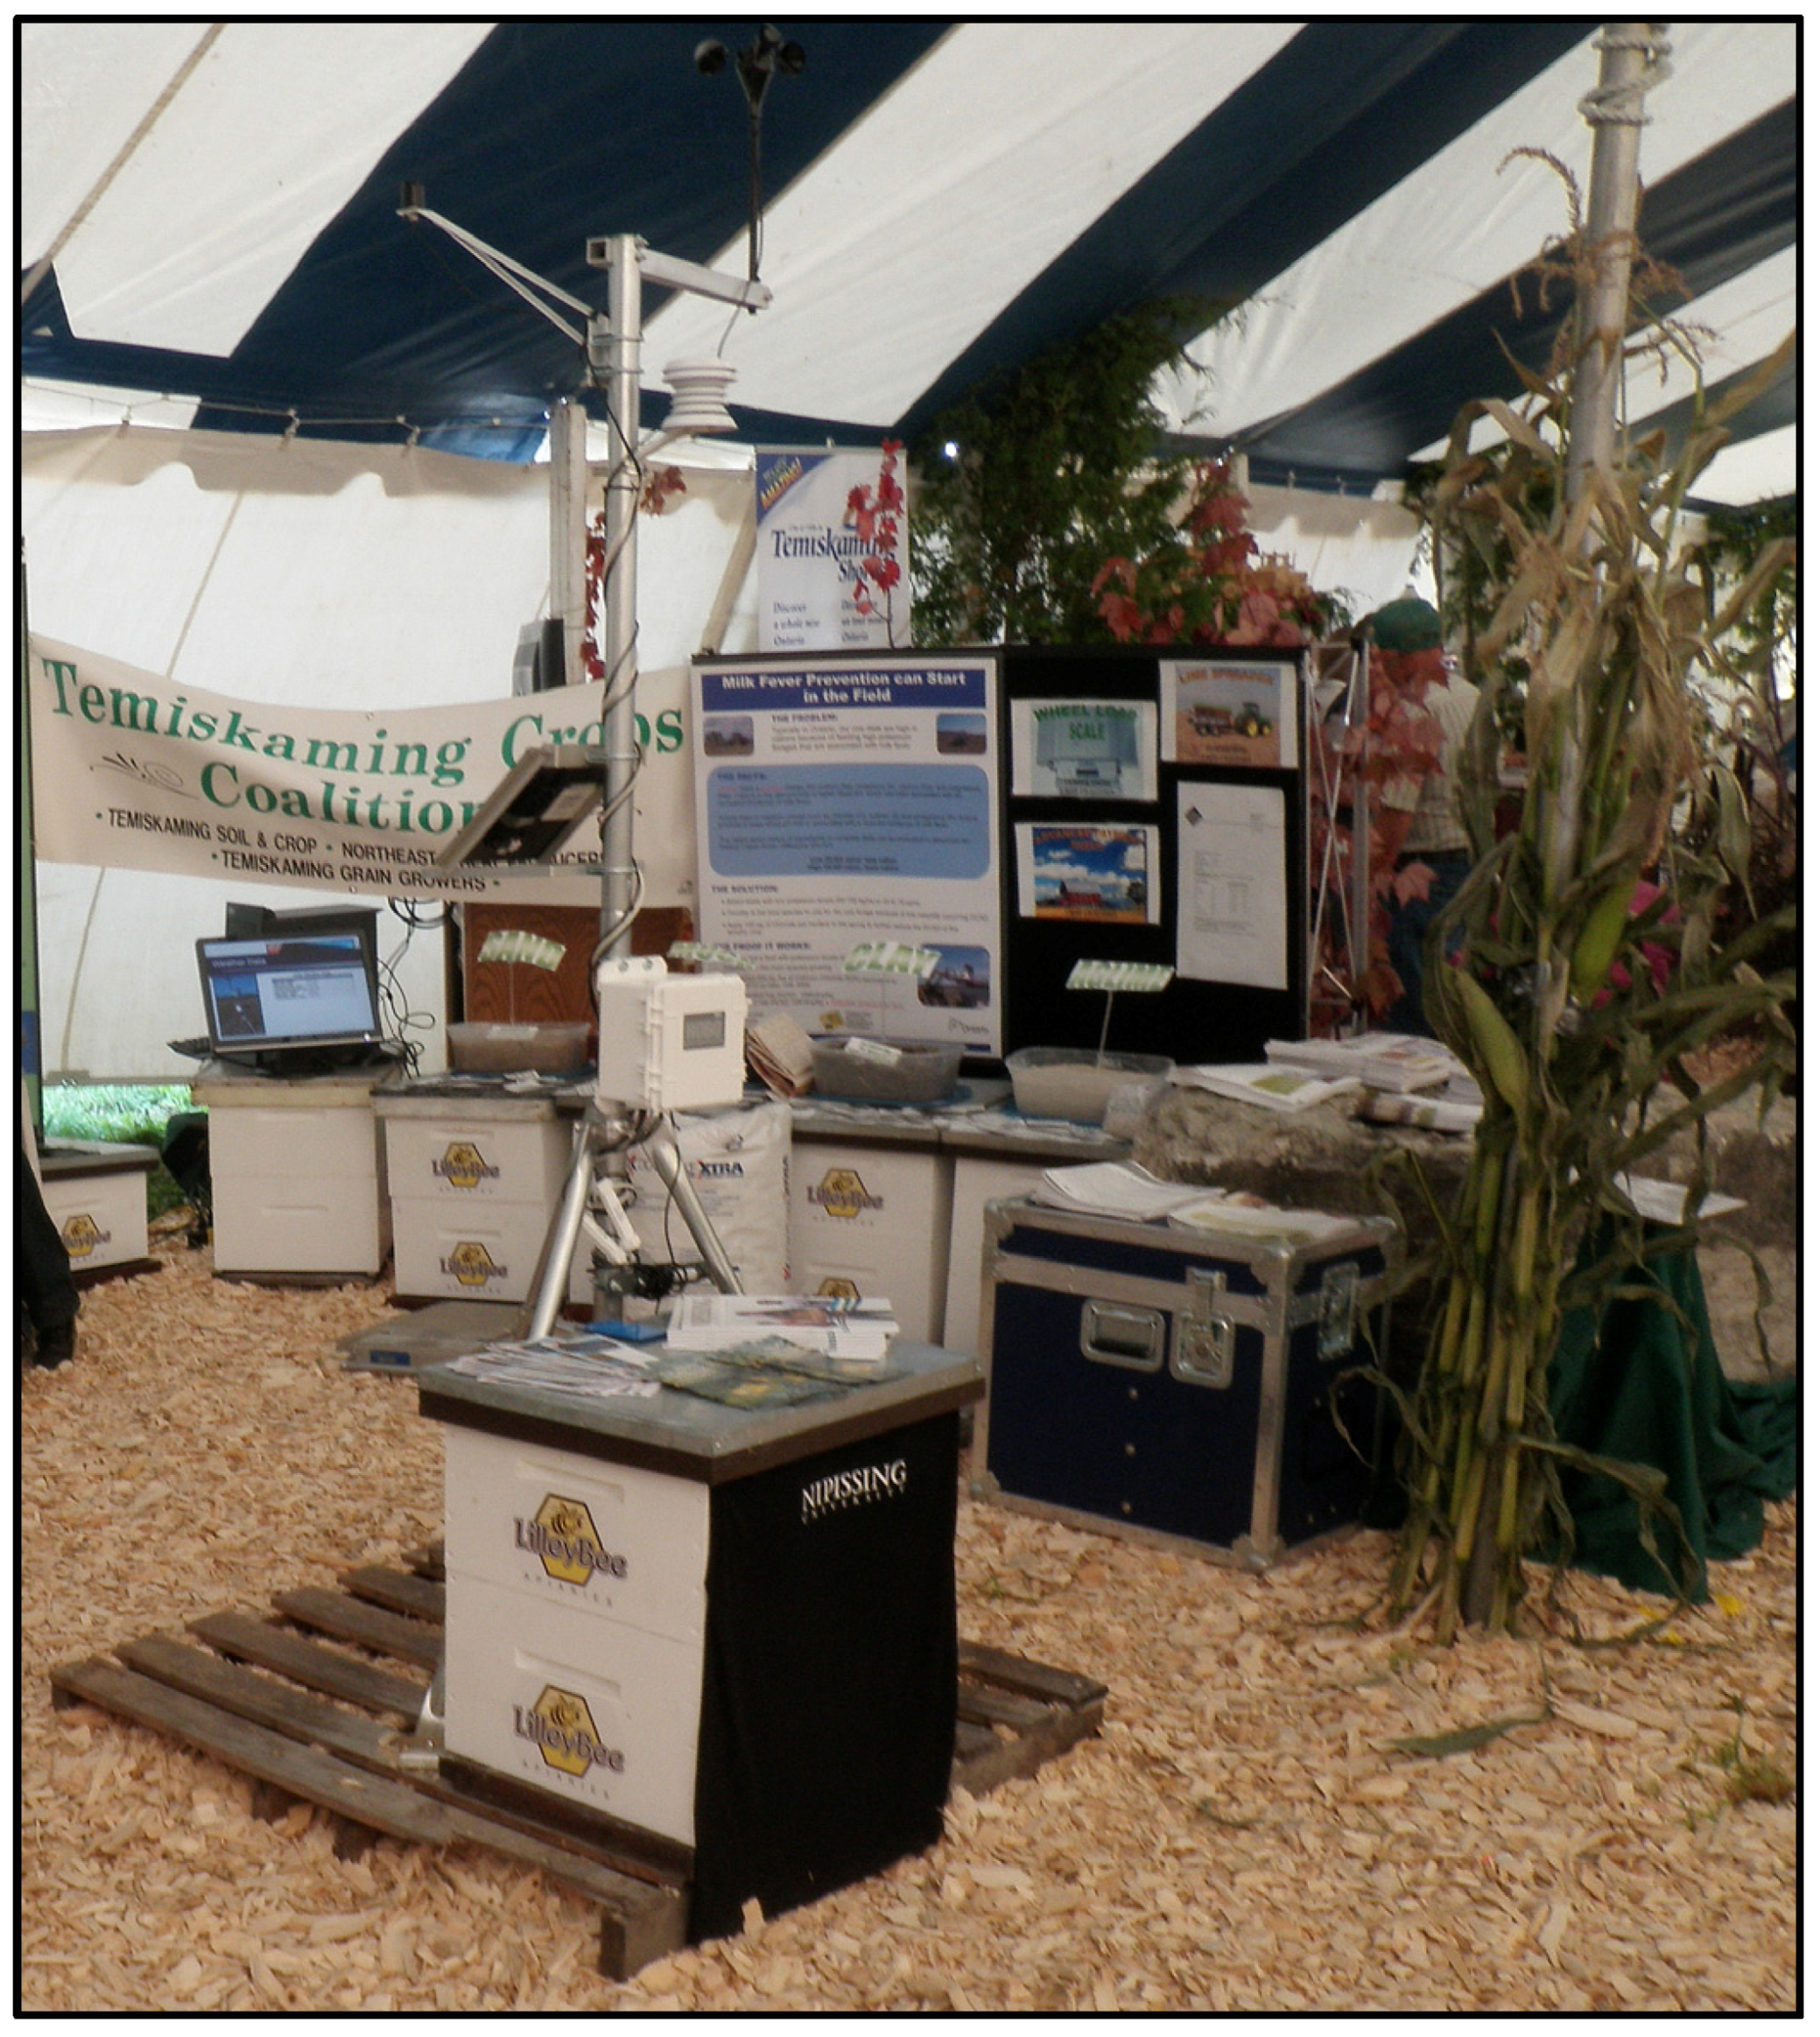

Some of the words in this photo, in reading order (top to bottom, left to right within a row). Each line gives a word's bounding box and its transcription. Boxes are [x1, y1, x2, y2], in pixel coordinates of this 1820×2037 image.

[722, 673, 755, 690] Milk
[759, 671, 803, 689] Fever
[806, 670, 890, 687] Prevention
[894, 672, 924, 686] can
[926, 670, 966, 686] Start
[803, 689, 819, 704] in
[823, 687, 850, 704] the
[853, 686, 892, 703] Field
[41, 657, 472, 787] Temiskaming
[1034, 704, 1091, 723] WHEEL
[1069, 722, 1106, 741] SCALE
[108, 808, 211, 839] TEMISKAMING
[217, 825, 250, 846] SOIL
[256, 831, 267, 848] &
[274, 832, 317, 854] CROP
[341, 842, 437, 866] NORTHEAST
[221, 850, 335, 881] TEMISKAMING
[341, 863, 392, 885] GRAIN
[699, 1159, 744, 1177] XTRA
[801, 1458, 908, 1514] NIPISSING
[513, 1516, 629, 1579] LilleyBee
[511, 1704, 626, 1774] LilleyBee
